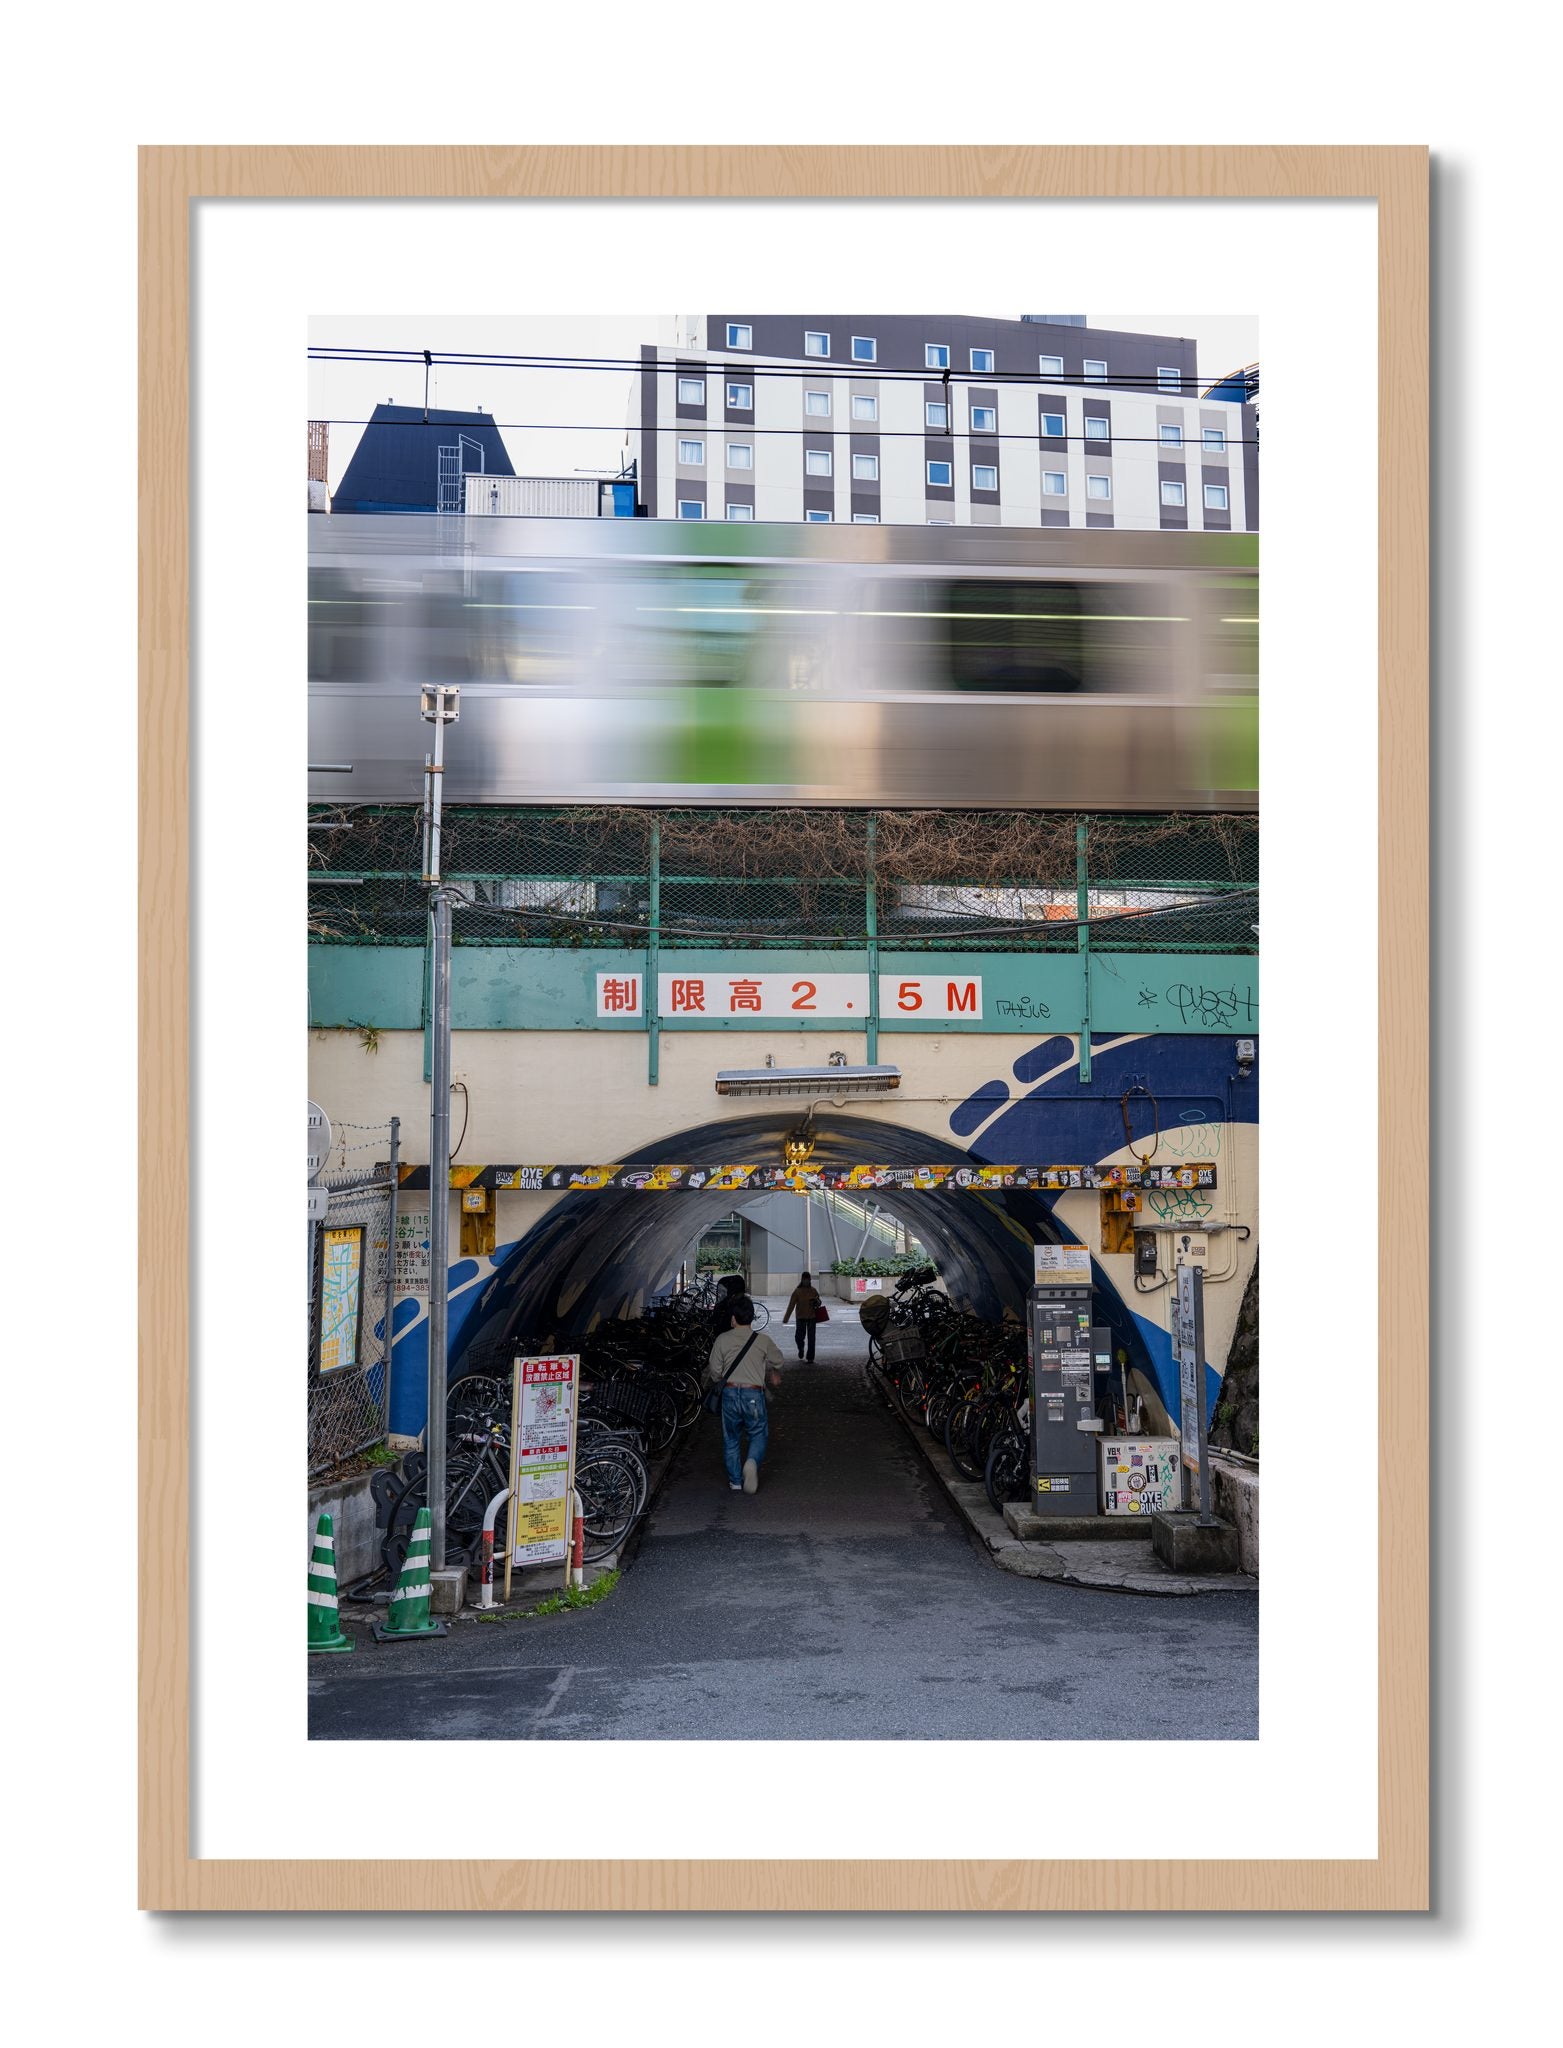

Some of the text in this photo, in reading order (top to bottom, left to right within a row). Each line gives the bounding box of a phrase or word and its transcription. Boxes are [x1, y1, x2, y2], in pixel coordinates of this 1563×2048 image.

[521, 1167, 544, 1179] OYE
[1198, 1169, 1212, 1177] OYE
[520, 1178, 543, 1190] RUNS
[1140, 1492, 1162, 1503] OYE
[1140, 1502, 1162, 1514] RUNS
